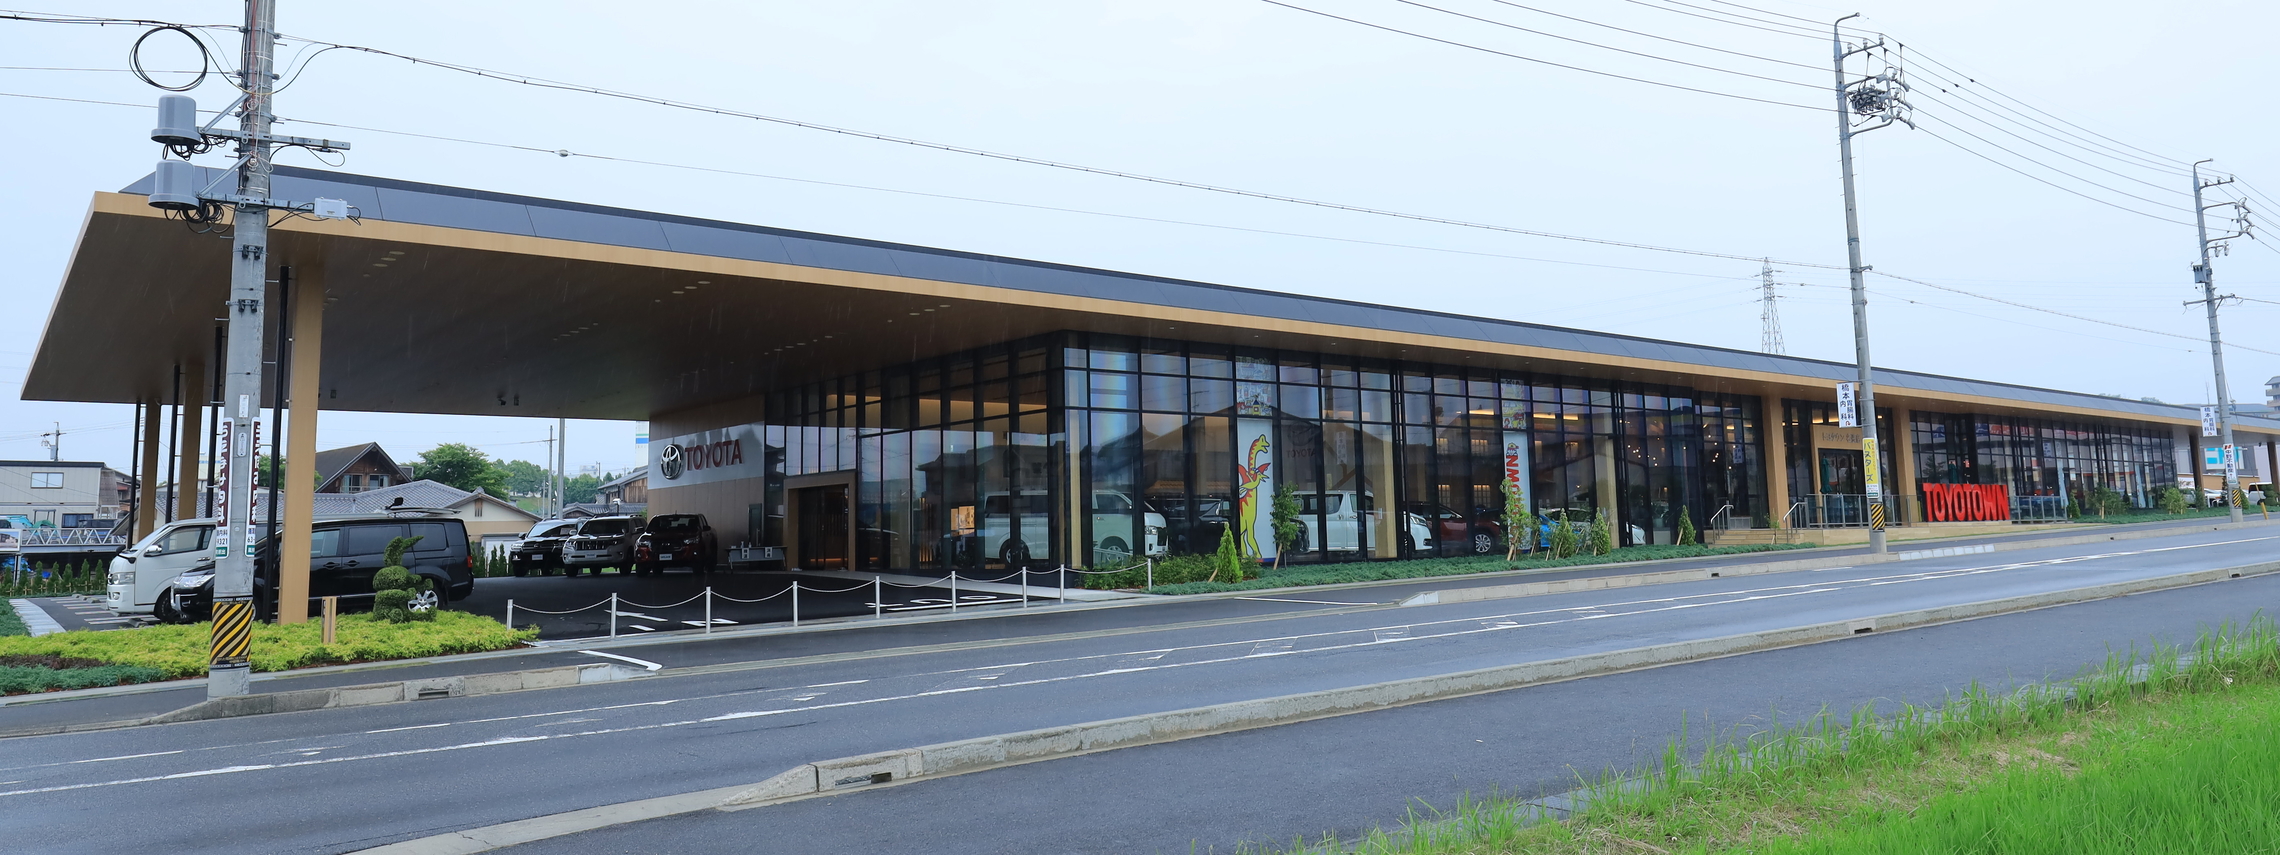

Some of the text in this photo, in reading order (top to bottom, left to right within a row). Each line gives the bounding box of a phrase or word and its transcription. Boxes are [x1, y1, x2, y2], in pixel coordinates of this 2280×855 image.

[685, 439, 743, 471] TOYOTA
[1286, 448, 1316, 458] TOYOTA
[1864, 442, 1874, 482] バスターズ
[1923, 483, 2010, 521] TOYOTOWN
